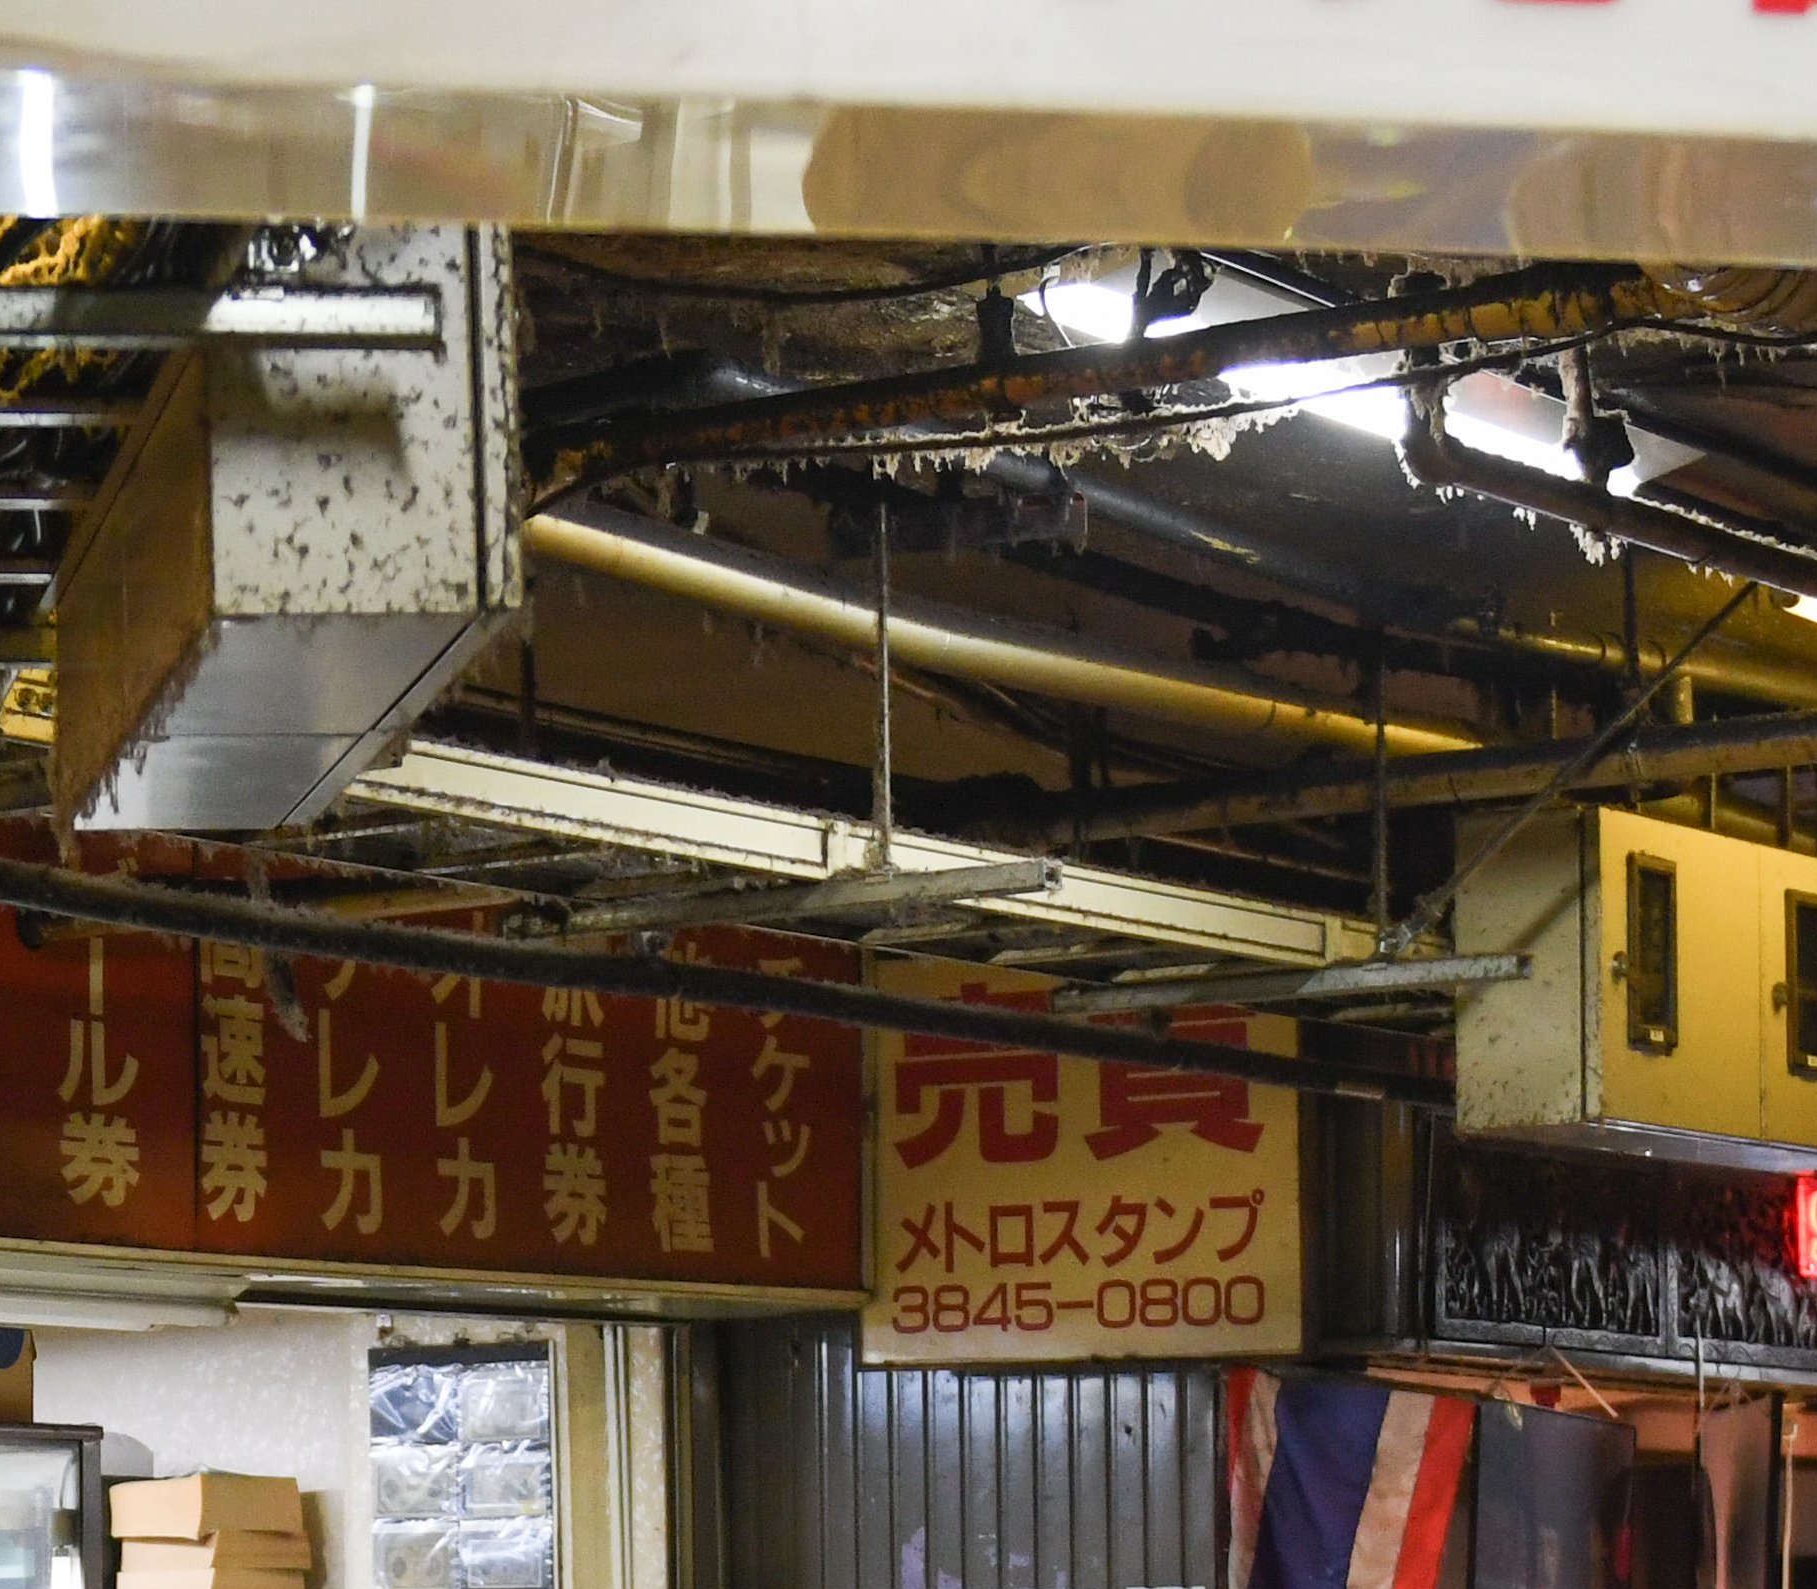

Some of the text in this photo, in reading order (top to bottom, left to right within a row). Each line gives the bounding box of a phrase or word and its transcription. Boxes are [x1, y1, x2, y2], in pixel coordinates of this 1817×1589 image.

[58, 935, 140, 1207] ール券
[895, 980, 1265, 1168] 売買
[899, 1190, 1264, 1272] メトロスタンプ
